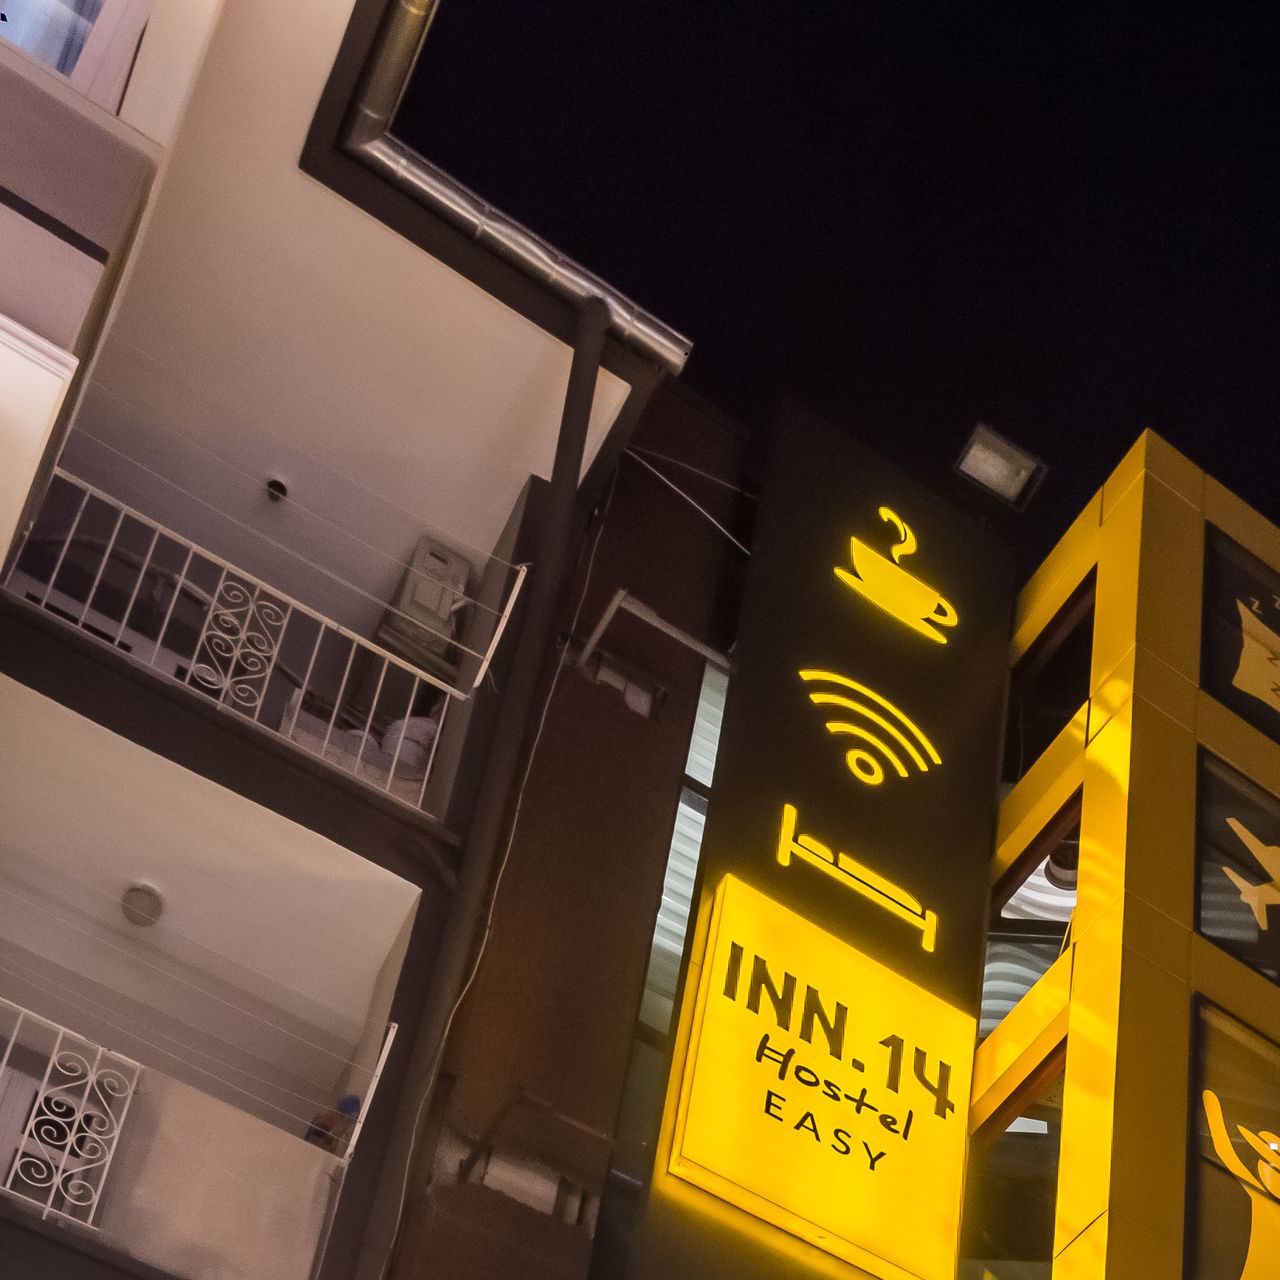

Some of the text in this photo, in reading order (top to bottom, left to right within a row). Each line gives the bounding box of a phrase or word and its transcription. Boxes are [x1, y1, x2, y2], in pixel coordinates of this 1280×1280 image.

[722, 940, 956, 1121] INN.14
[755, 1033, 914, 1141] Hostel
[764, 1089, 887, 1172] EASY
